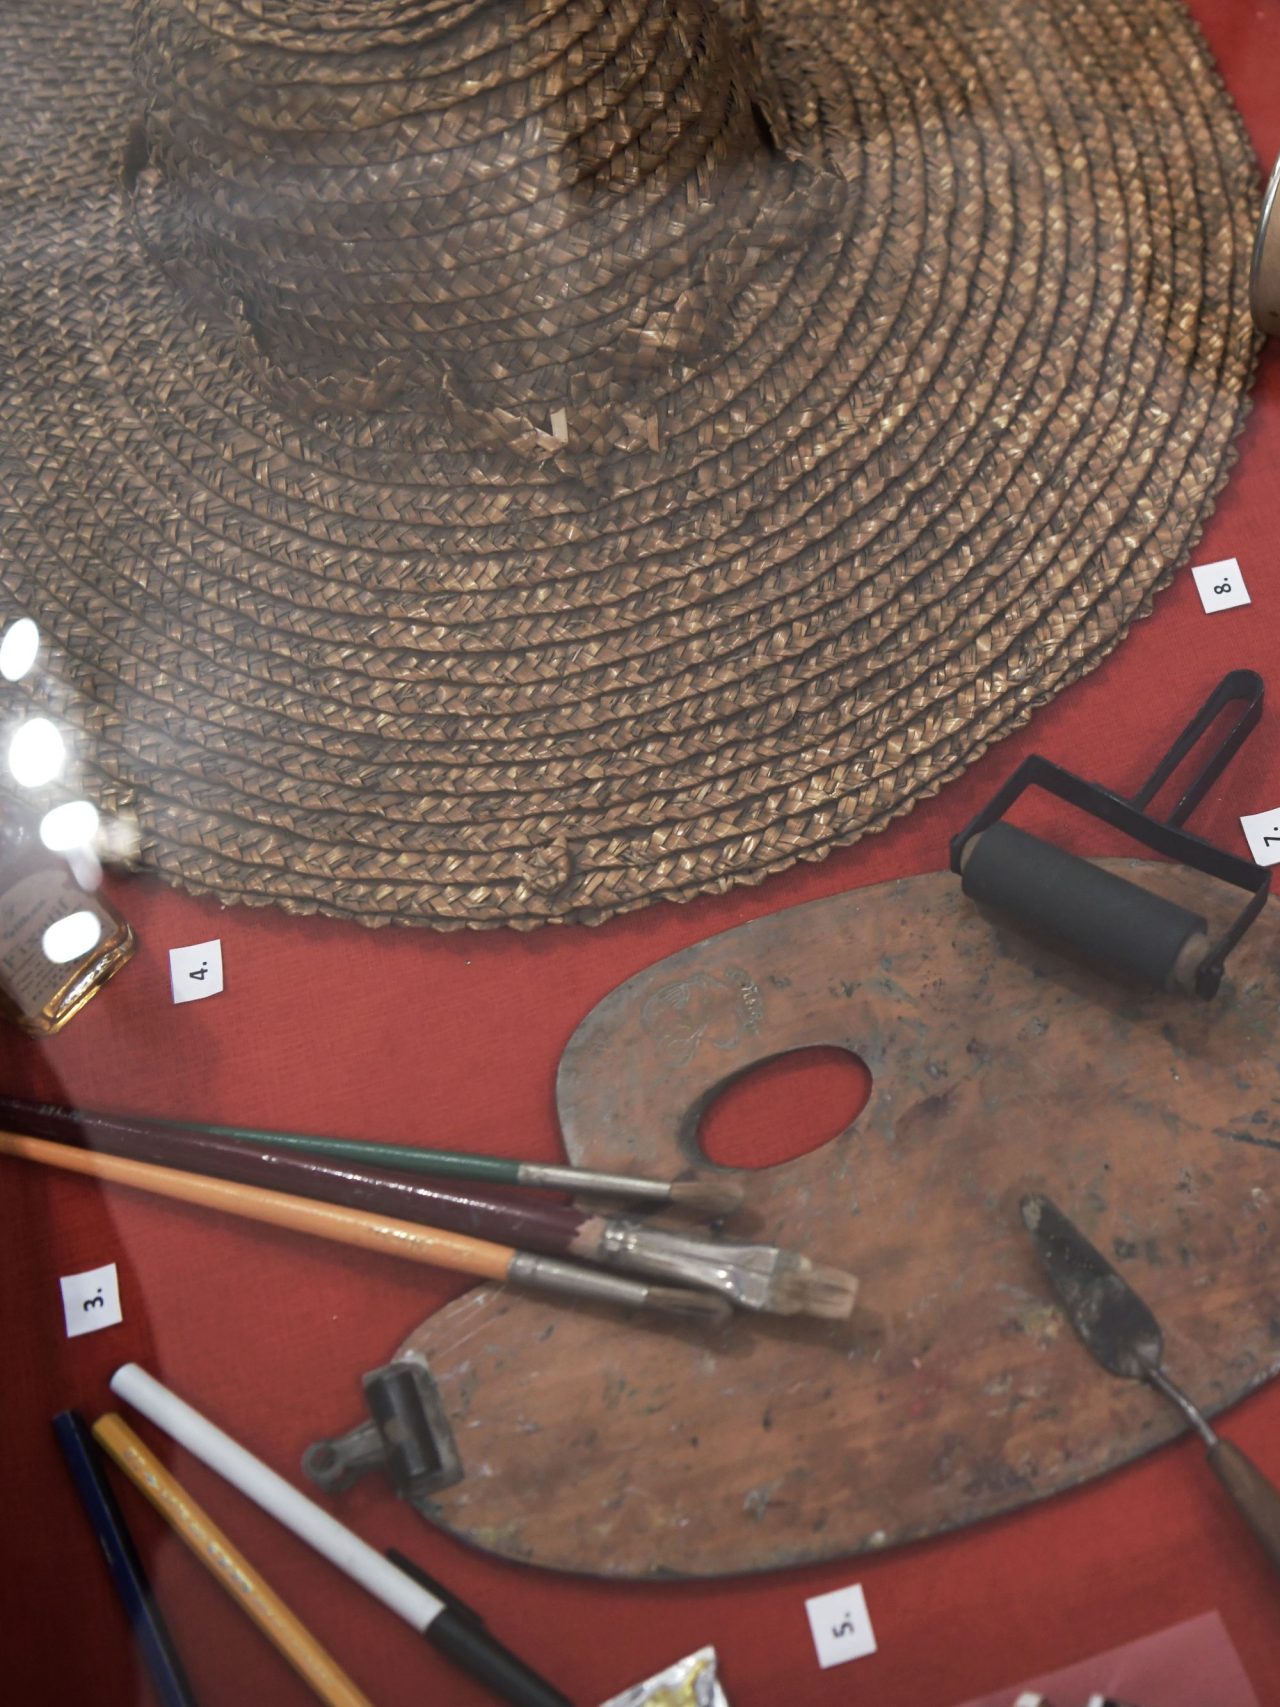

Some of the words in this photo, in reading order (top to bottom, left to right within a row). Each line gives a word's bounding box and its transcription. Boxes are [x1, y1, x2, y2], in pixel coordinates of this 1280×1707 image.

[1213, 576, 1232, 595] 8.
[188, 961, 208, 980] 4.
[82, 1287, 103, 1313] 3.
[830, 1611, 855, 1639] 5.
